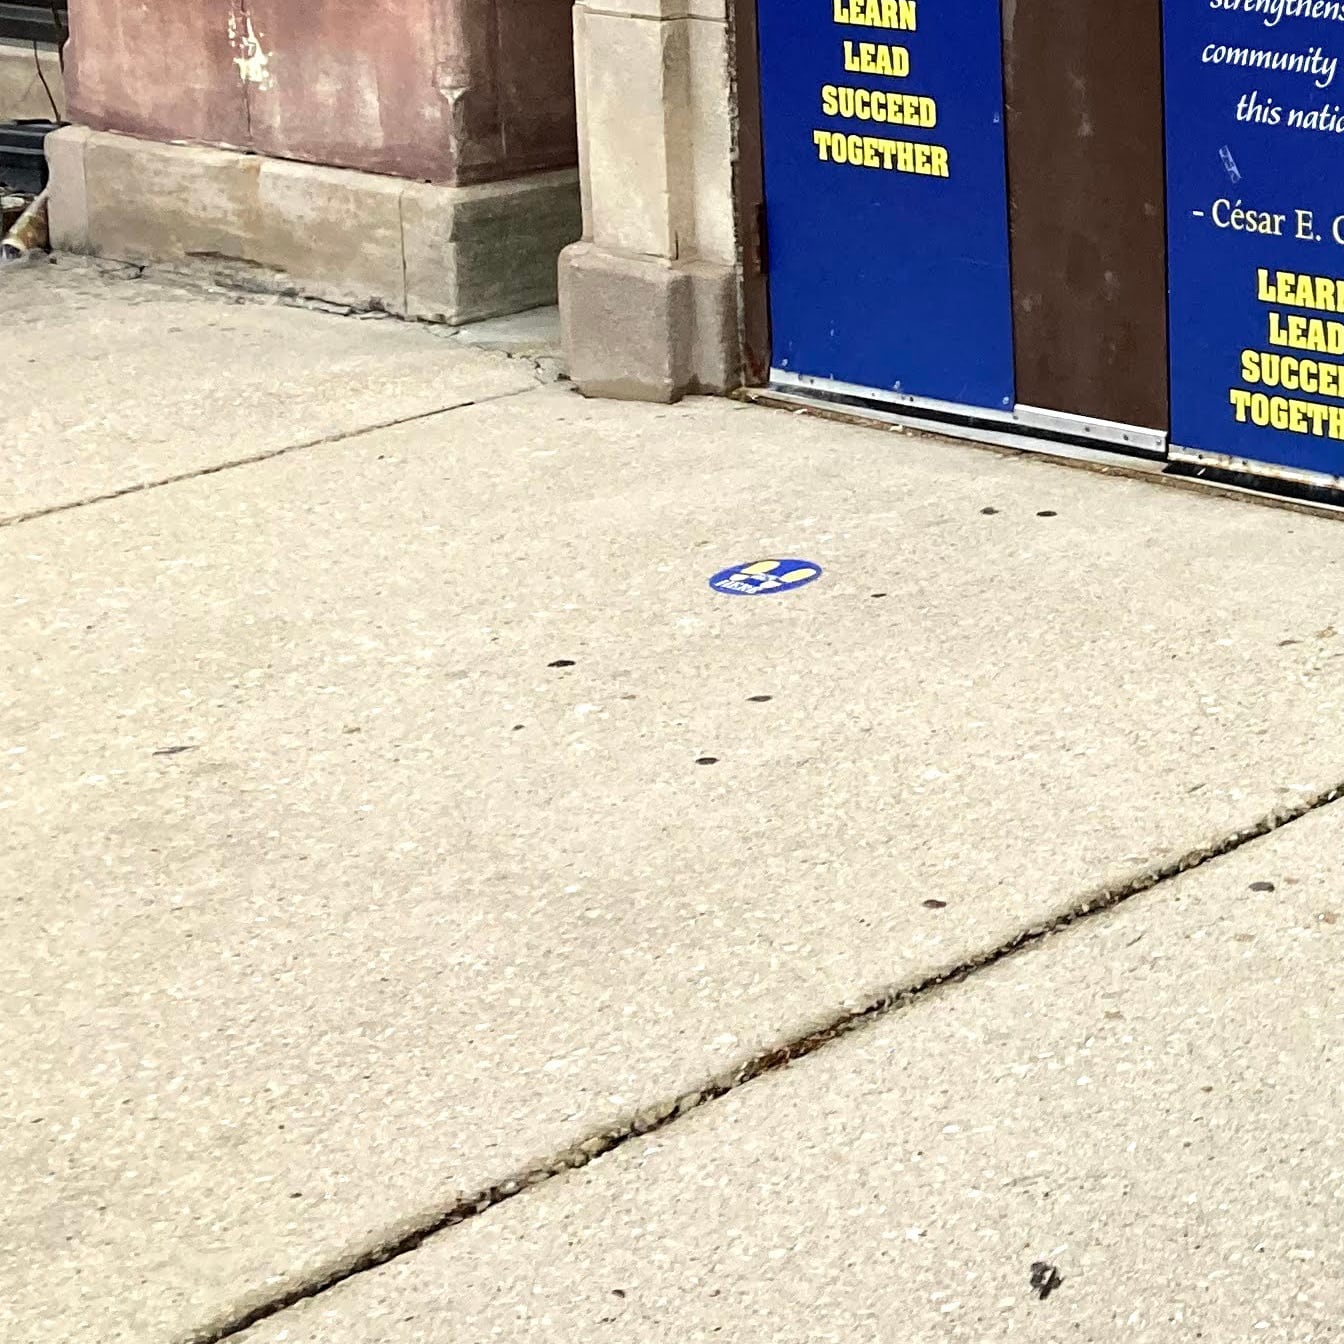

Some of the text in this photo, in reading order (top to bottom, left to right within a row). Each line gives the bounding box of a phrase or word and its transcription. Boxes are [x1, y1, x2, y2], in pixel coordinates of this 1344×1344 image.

[843, 40, 910, 78] LEAD
[1201, 41, 1338, 88] community
[821, 84, 936, 129] SUCCEED
[1235, 90, 1281, 126] this
[813, 129, 949, 178] TOGETHER
[1212, 198, 1286, 237] César
[1295, 209, 1321, 242] E.
